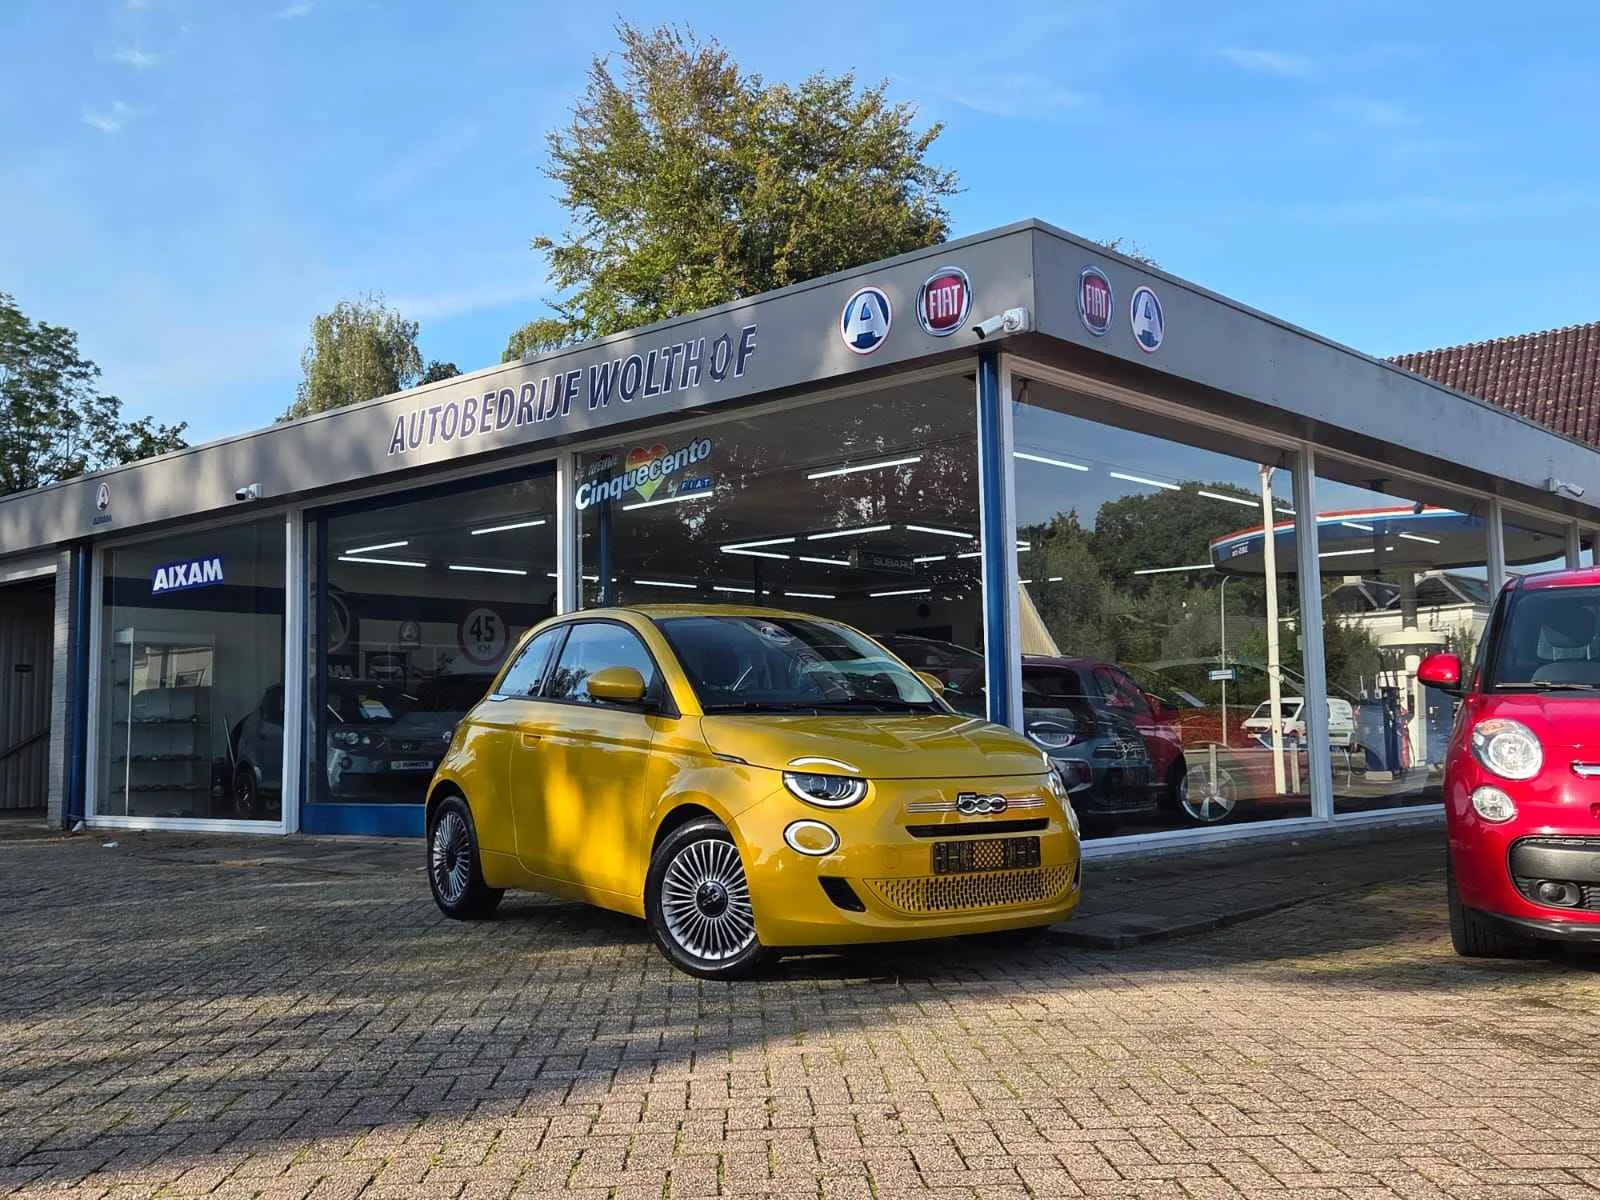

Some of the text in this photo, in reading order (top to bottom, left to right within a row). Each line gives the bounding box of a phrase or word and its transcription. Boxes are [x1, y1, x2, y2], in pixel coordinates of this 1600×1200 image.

[928, 283, 961, 320] FIAT
[1084, 283, 1109, 318] FIAT
[387, 369, 582, 456] AUTOBEDRIJF
[575, 437, 712, 510] Cinquecento
[681, 478, 711, 490] FIAT
[152, 558, 223, 592] AIXAM
[470, 615, 496, 642] 45
[957, 792, 1007, 815] 500
